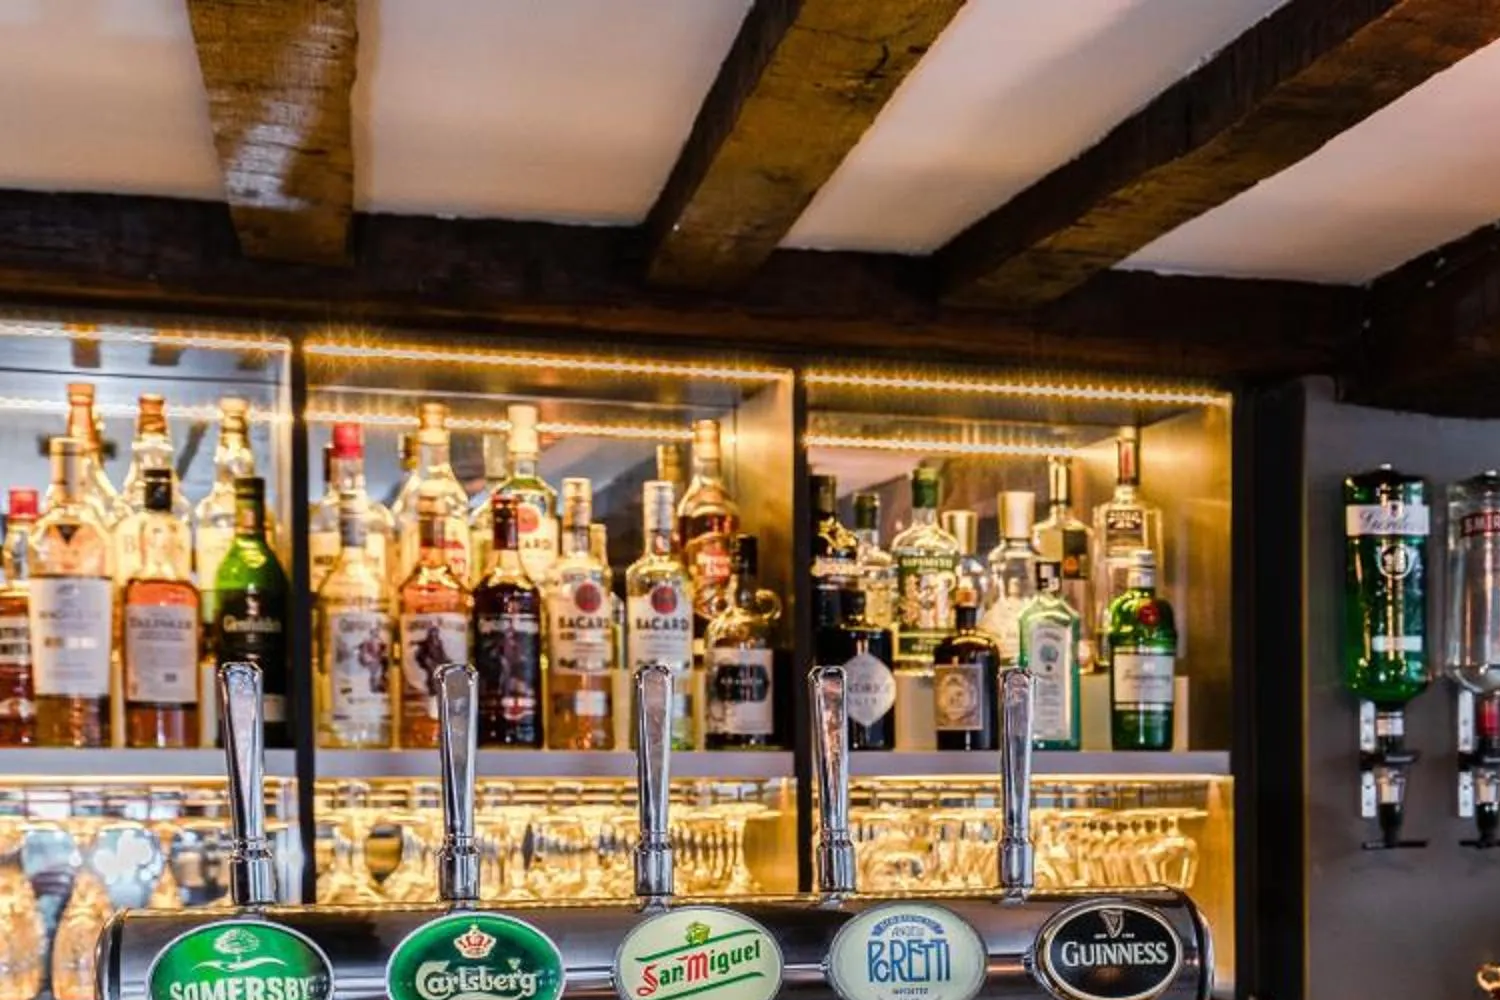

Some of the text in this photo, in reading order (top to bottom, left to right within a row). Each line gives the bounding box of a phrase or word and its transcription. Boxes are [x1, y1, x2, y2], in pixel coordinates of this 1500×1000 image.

[636, 938, 761, 997] San Miguel
[1061, 940, 1169, 967] GUINNESS
